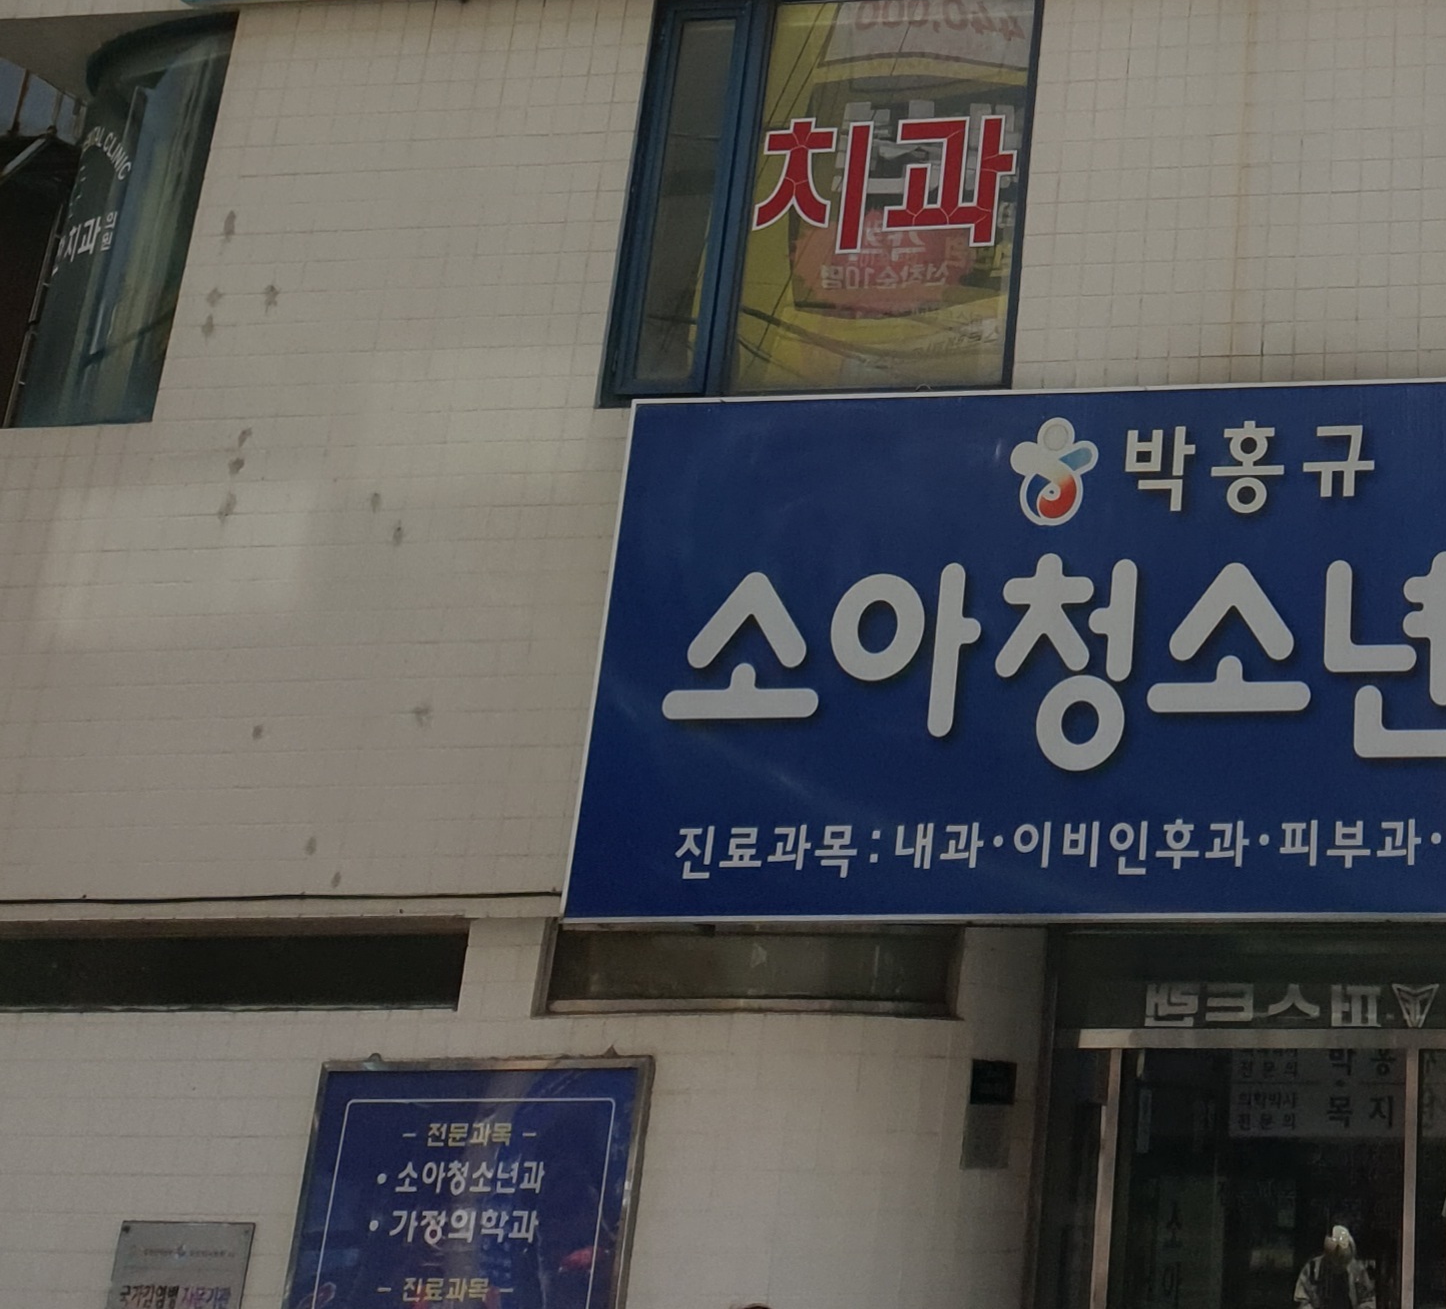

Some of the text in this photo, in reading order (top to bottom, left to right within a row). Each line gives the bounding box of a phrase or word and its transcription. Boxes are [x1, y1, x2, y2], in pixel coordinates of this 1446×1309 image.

[103, 131, 132, 181] CLINIC
[751, 114, 1018, 255] 치과
[1125, 420, 1375, 514] 박홍규
[427, 1122, 512, 1147] 전문과목
[395, 1160, 545, 1196] 소아청소년과
[389, 1209, 539, 1245] 가정의학과
[402, 1277, 490, 1303] 진료과목
